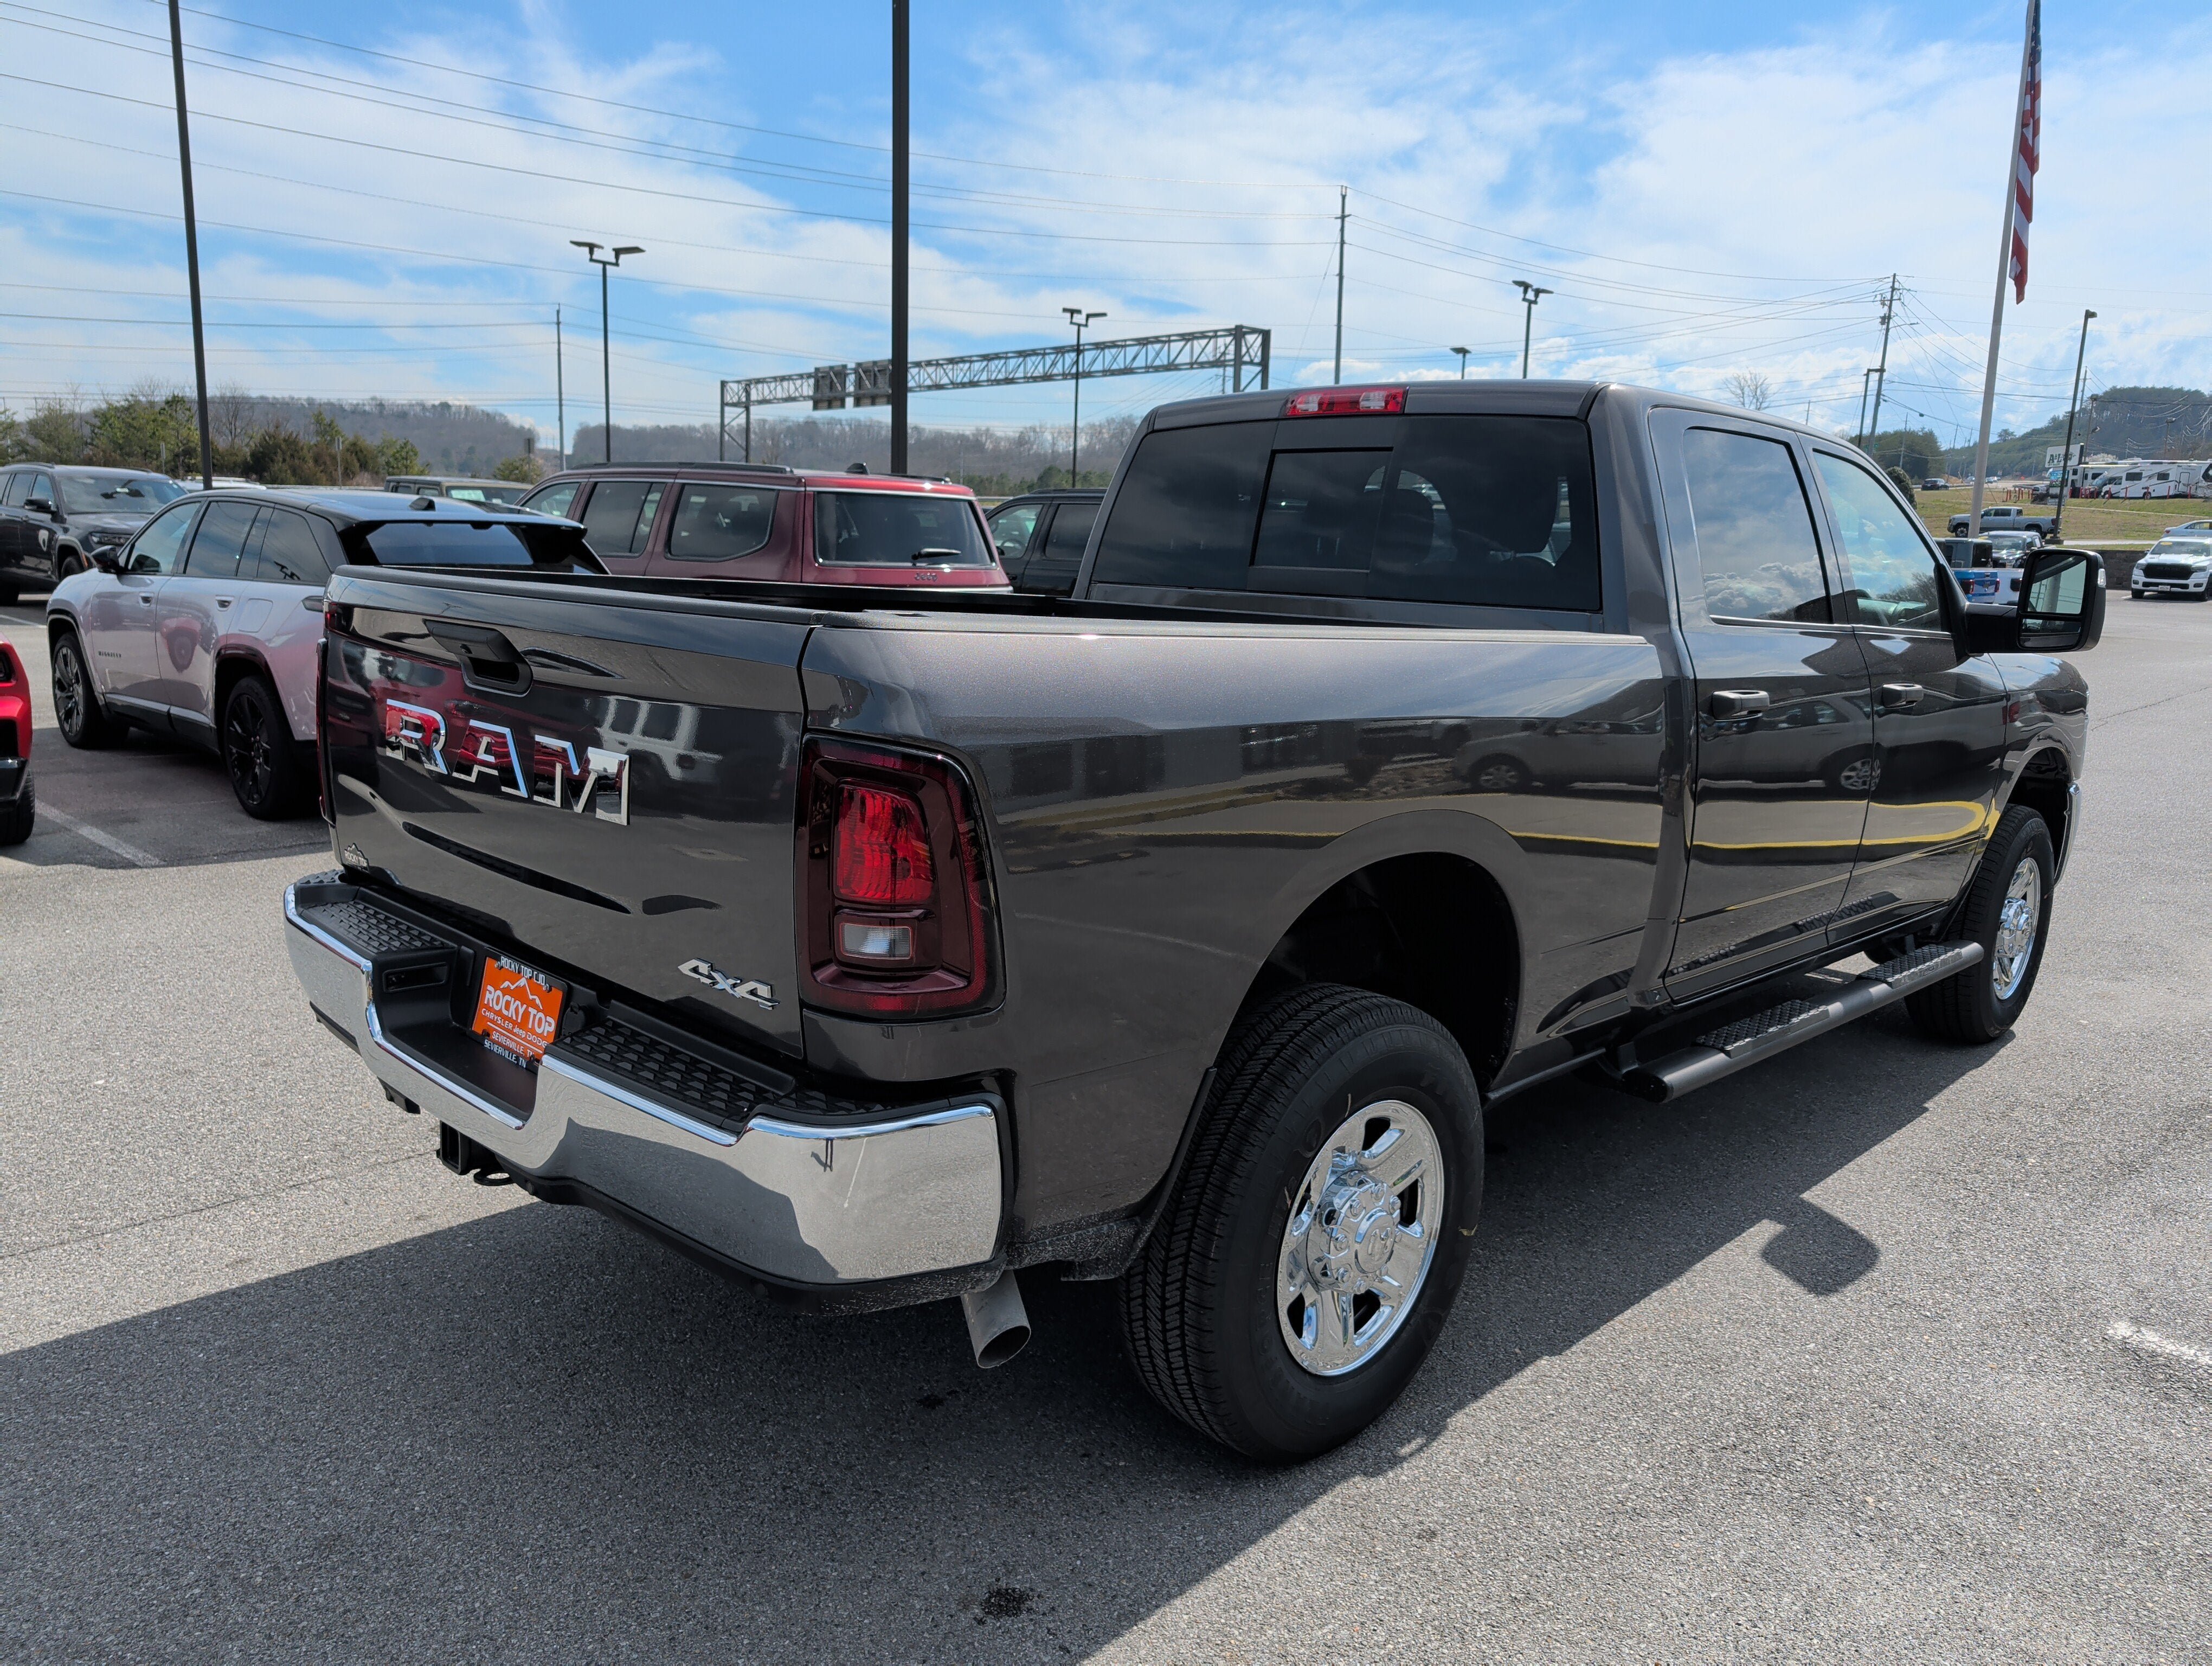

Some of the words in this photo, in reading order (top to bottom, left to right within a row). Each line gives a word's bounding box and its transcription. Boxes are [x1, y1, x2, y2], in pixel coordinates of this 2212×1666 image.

[385, 698, 631, 826] RAM
[344, 850, 358, 863] ROCKY
[358, 857, 367, 867] TOP
[500, 956, 519, 974] ROCKY
[520, 965, 532, 979] TOP
[484, 984, 526, 1023] ROCKY
[528, 1008, 555, 1036] TOP
[481, 1008, 513, 1030] CHRYSLER
[513, 1024, 526, 1038] Jeep
[526, 1031, 550, 1049] DODG
[491, 1031, 525, 1056] SEVIERVILLE,
[484, 1039, 517, 1064] SEVIERVILLE,
[519, 1057, 528, 1069] TN
